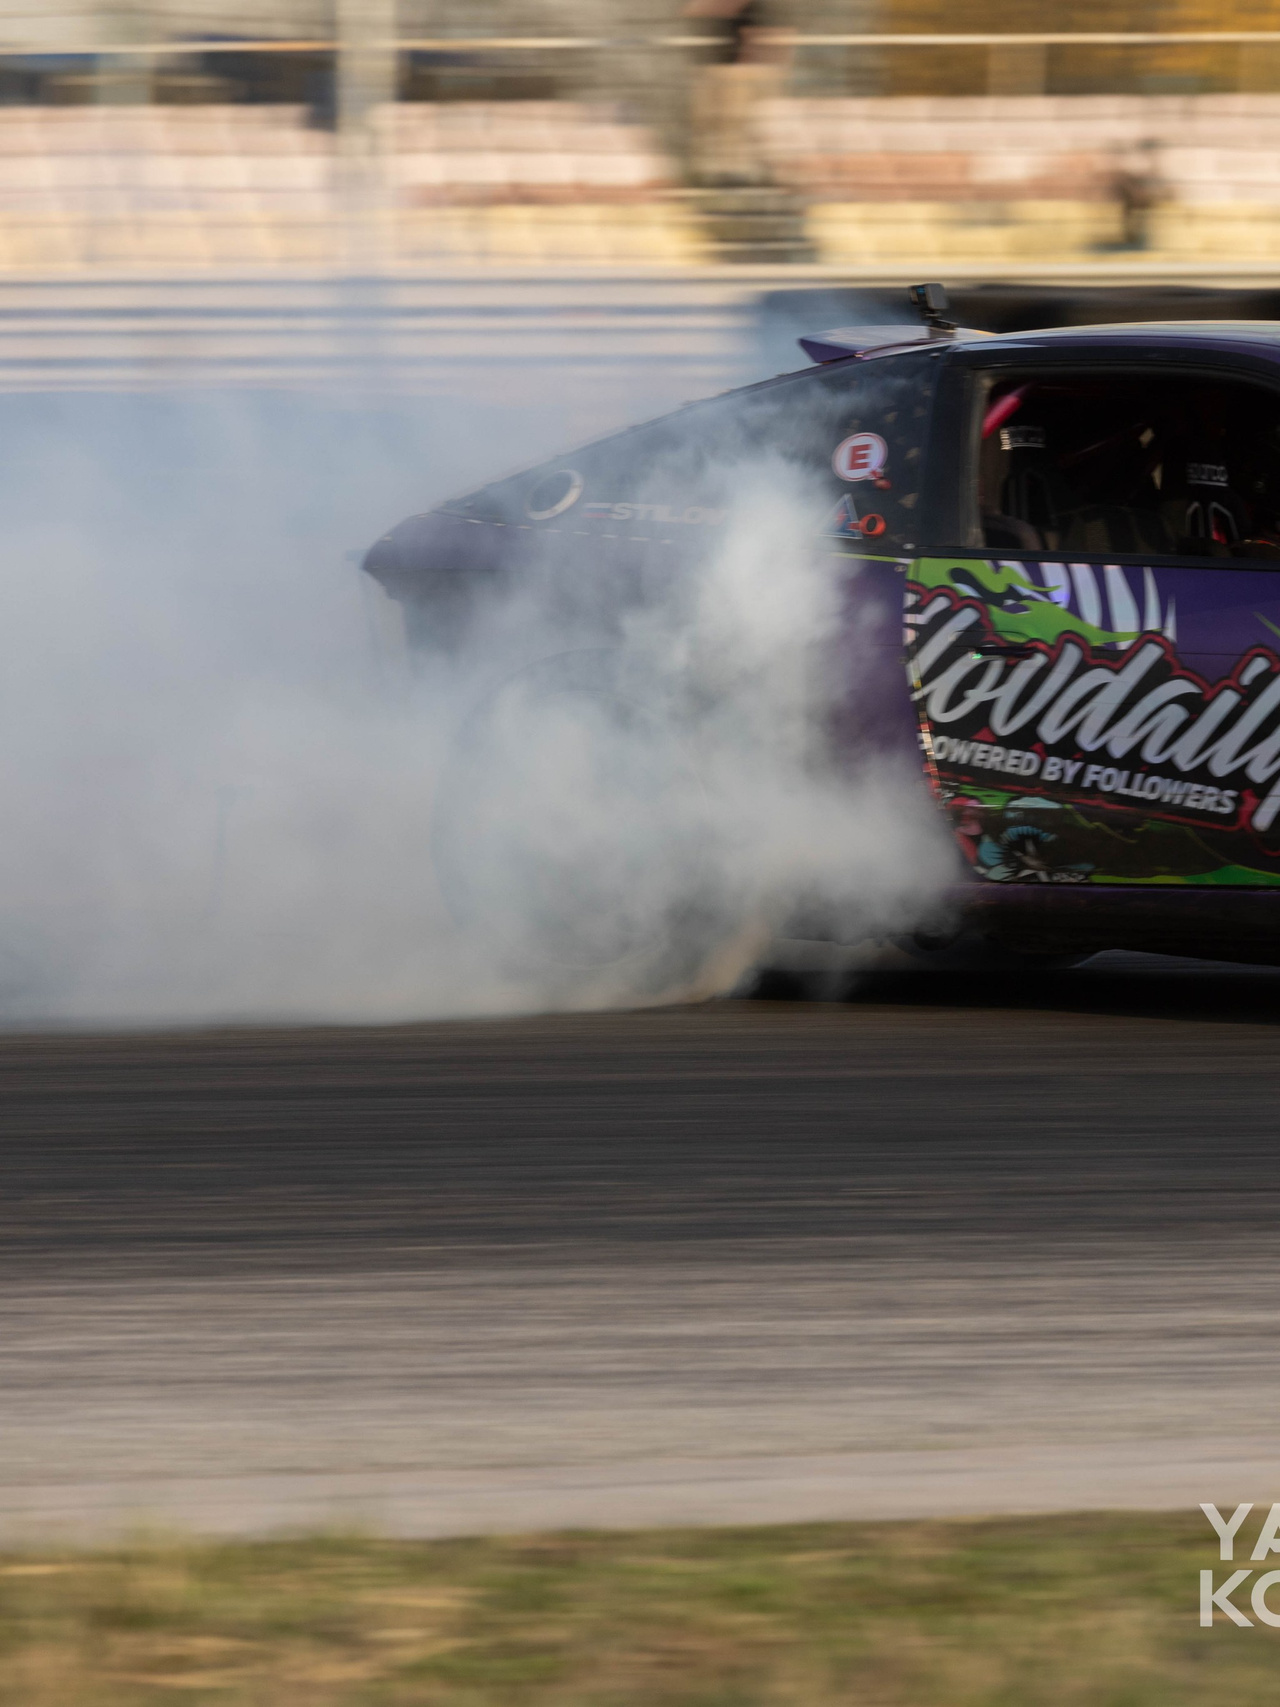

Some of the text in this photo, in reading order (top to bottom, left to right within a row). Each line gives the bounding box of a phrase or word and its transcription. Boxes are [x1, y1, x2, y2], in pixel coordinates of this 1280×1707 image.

[847, 444, 872, 470] E
[1041, 756, 1083, 784] BY
[1081, 764, 1239, 814] FOLLOWERS
